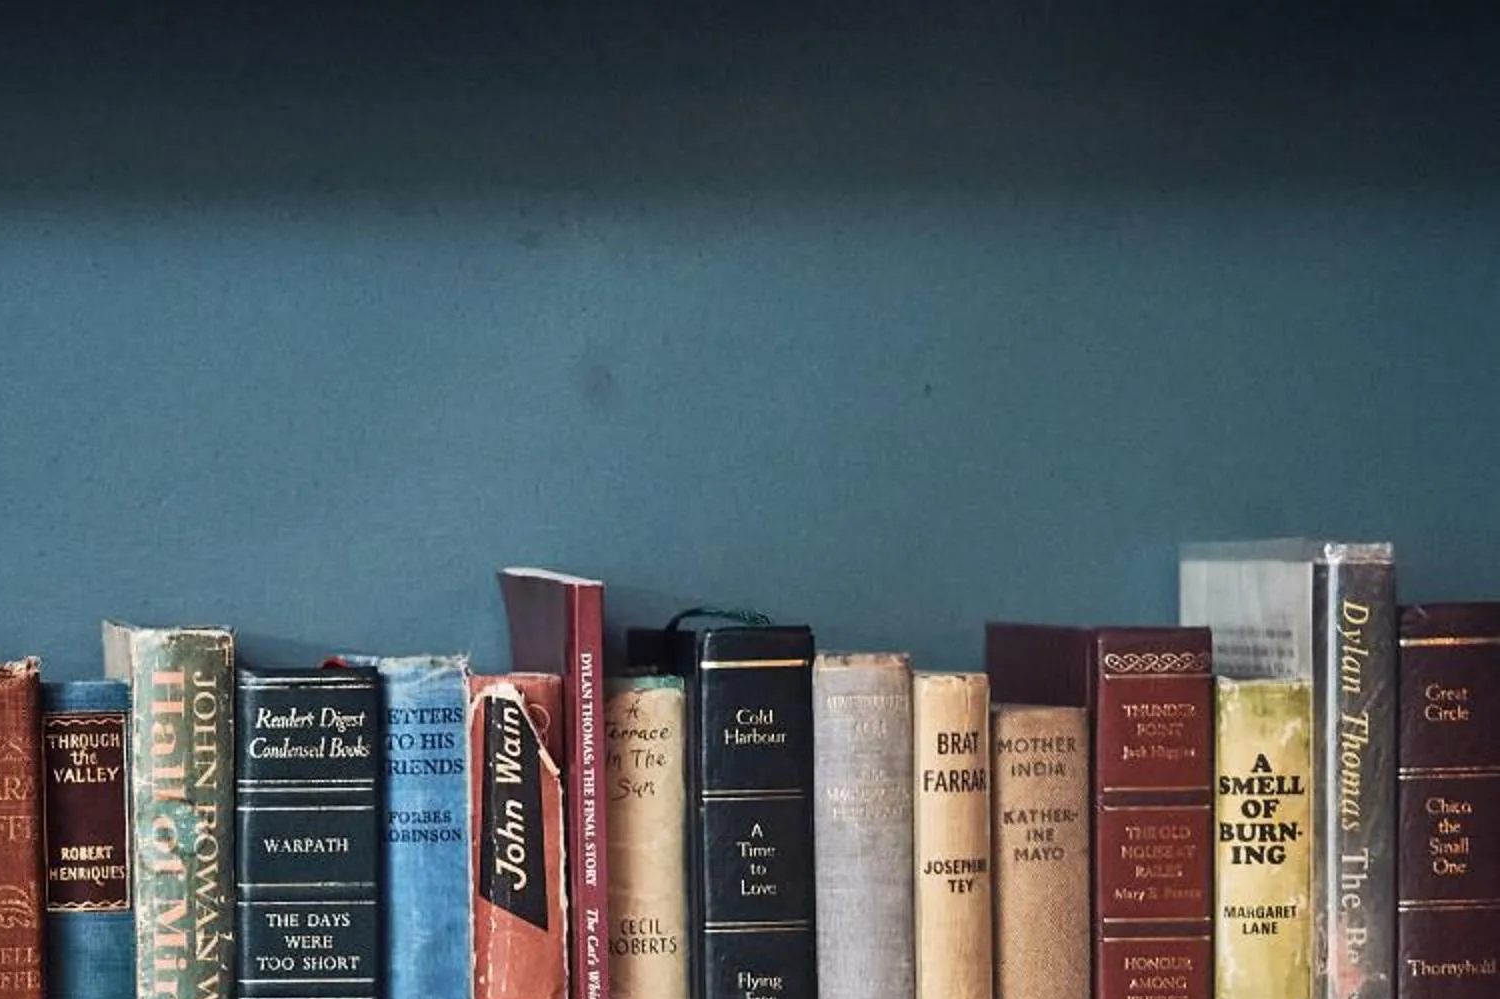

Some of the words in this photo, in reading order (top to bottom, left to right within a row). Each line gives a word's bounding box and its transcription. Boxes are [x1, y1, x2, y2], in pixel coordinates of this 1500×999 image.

[1336, 601, 1369, 694] Dylan
[580, 653, 592, 702] DYLAN
[1425, 685, 1468, 703] Great
[320, 708, 365, 732] Digest
[736, 710, 773, 725] Cold
[1424, 704, 1469, 721] Circle
[151, 668, 188, 801] Hall
[193, 671, 217, 788] JOHN
[724, 729, 787, 745] Harbour
[47, 734, 120, 749] THROUGH
[250, 737, 324, 759] Condensed
[329, 738, 371, 758] Books
[388, 734, 414, 750] TO
[420, 733, 455, 749] HIS
[495, 707, 522, 785] Wain
[937, 732, 979, 755] BRAT
[997, 736, 1076, 754] MOTHER
[70, 750, 98, 765] the
[1251, 754, 1272, 772] A
[54, 768, 120, 783] VALLEY
[1012, 762, 1066, 777] INDIA
[1340, 712, 1369, 831] Thomas
[582, 767, 594, 805] THE
[923, 770, 987, 792] FARRAR
[1220, 776, 1304, 795] SMELL
[1004, 809, 1079, 824] KATHER-
[1241, 800, 1280, 818] OF
[583, 807, 596, 845] FINAL
[752, 824, 763, 837] A
[1220, 824, 1303, 842] BURN-
[1438, 818, 1461, 833] the
[1027, 828, 1054, 842] INE
[61, 846, 112, 860] ROBERT
[153, 814, 188, 882] of
[263, 838, 348, 852] WARPATH
[496, 800, 526, 891] John
[737, 842, 775, 857] Time
[1429, 837, 1469, 854] Small
[1014, 847, 1065, 861] MAYO
[1232, 847, 1286, 864] ING
[50, 865, 125, 885] HENRIQUES
[583, 847, 597, 886] STORY
[751, 862, 767, 875] to
[1433, 860, 1467, 874] One
[195, 801, 219, 962] ROWAN
[948, 880, 973, 893] TEY
[1341, 848, 1369, 908] The
[741, 880, 776, 895] Love
[266, 913, 299, 927] THE
[308, 912, 350, 926] DAYS
[1224, 906, 1297, 918] MARGARET
[585, 909, 598, 937] The
[620, 919, 662, 935] CECIL
[1242, 922, 1279, 934] LANE
[285, 935, 333, 948] WERE
[256, 957, 295, 971] TOO
[302, 957, 360, 970] SHORT
[738, 973, 782, 990] Flying
[1129, 976, 1187, 989] AMONG
